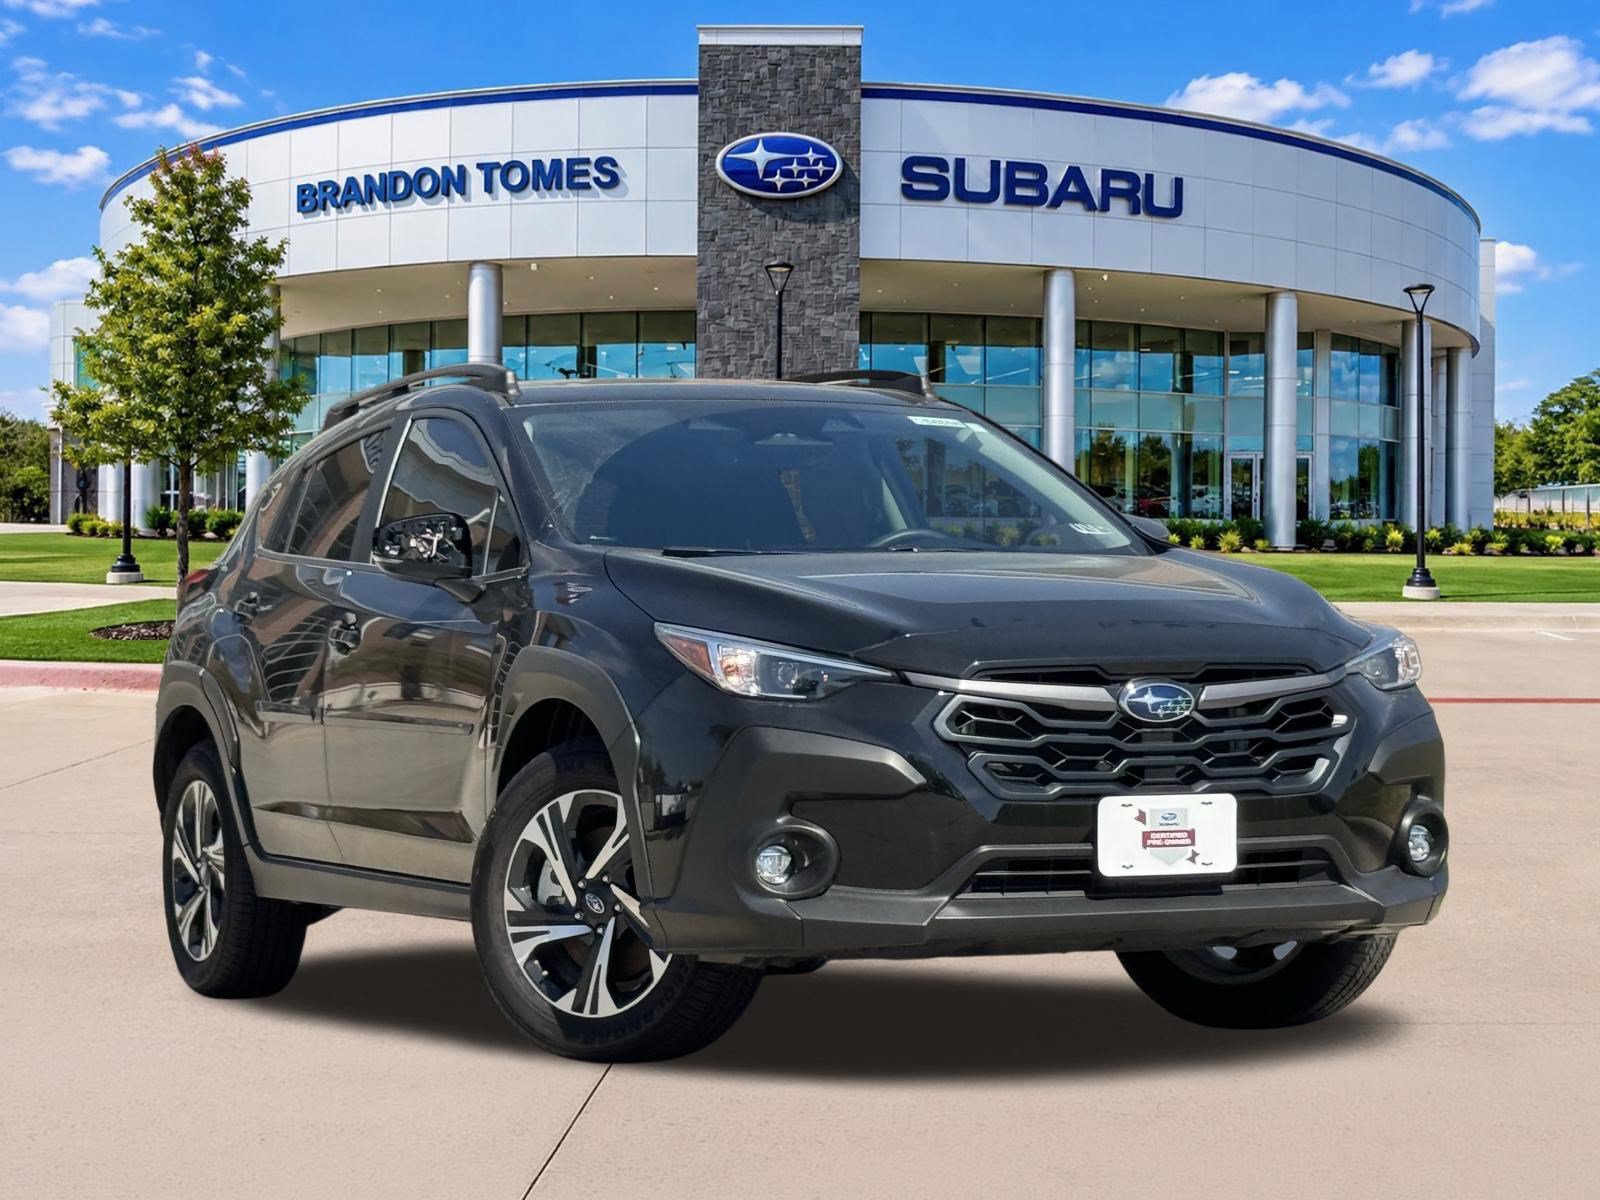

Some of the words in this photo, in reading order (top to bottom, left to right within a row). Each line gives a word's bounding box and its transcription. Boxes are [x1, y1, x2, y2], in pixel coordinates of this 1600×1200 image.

[297, 164, 465, 213] BRANDON
[476, 156, 620, 193] TOMES
[901, 155, 1184, 218] SUBARU
